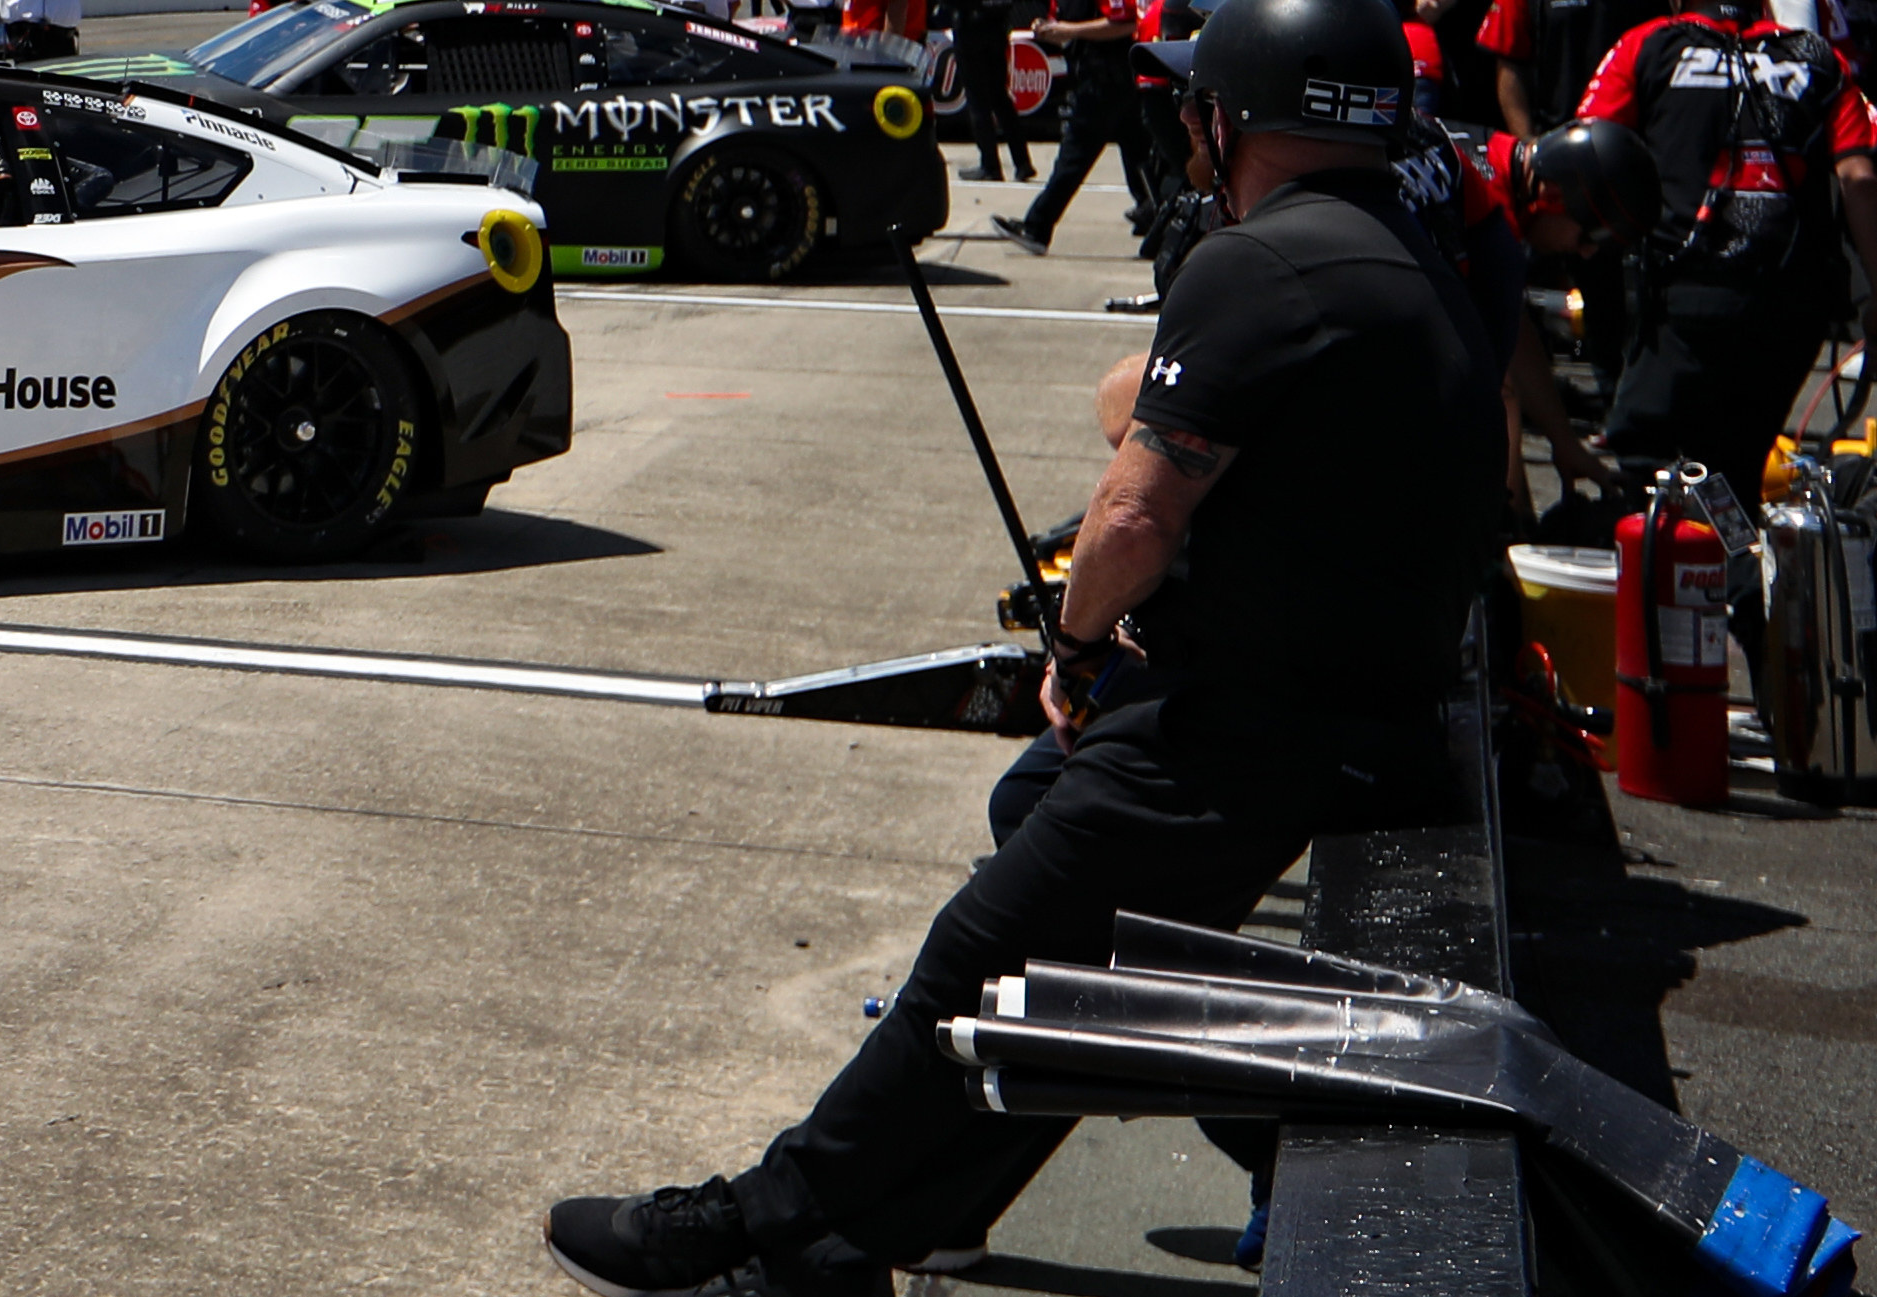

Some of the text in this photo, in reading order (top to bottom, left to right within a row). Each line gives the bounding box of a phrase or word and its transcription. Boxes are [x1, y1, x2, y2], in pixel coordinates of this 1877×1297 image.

[1013, 68, 1047, 94] heem
[551, 93, 847, 141] MONSTER
[552, 144, 667, 155] ENERGY
[583, 249, 628, 265] Mobil
[209, 322, 290, 487] GOODYEAR
[376, 420, 414, 510] EAGLE
[65, 515, 134, 541] Mobil
